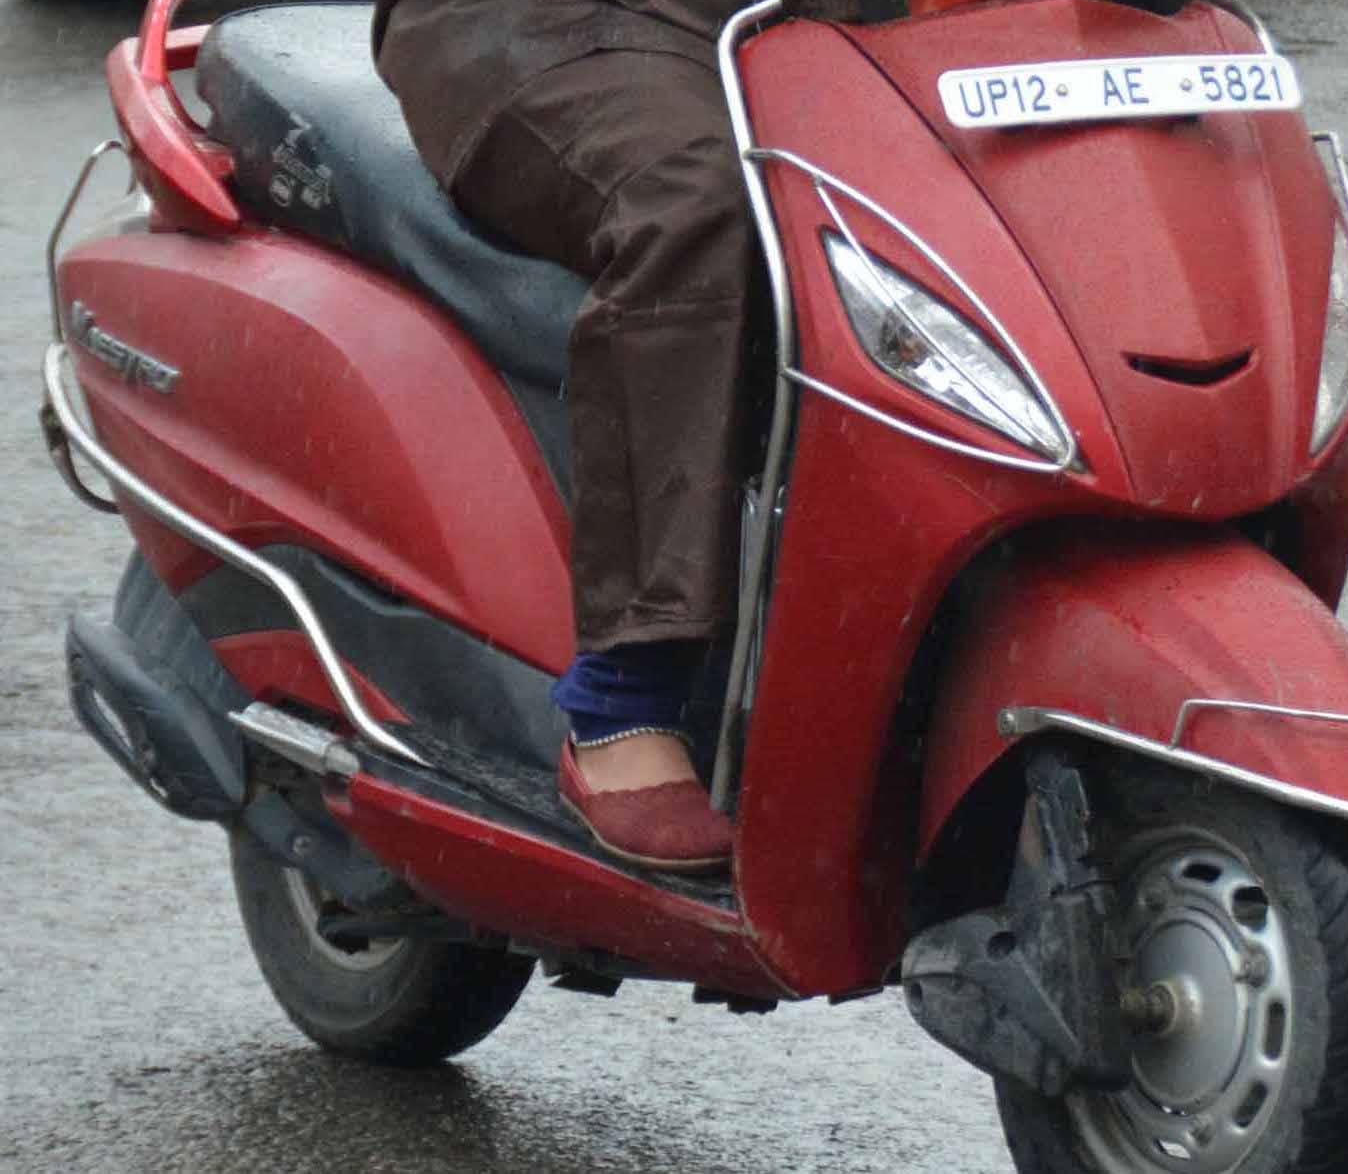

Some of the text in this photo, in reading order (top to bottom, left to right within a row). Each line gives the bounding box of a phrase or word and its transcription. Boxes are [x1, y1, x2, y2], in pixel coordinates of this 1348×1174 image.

[958, 64, 1285, 118] UP12 AE 5821
